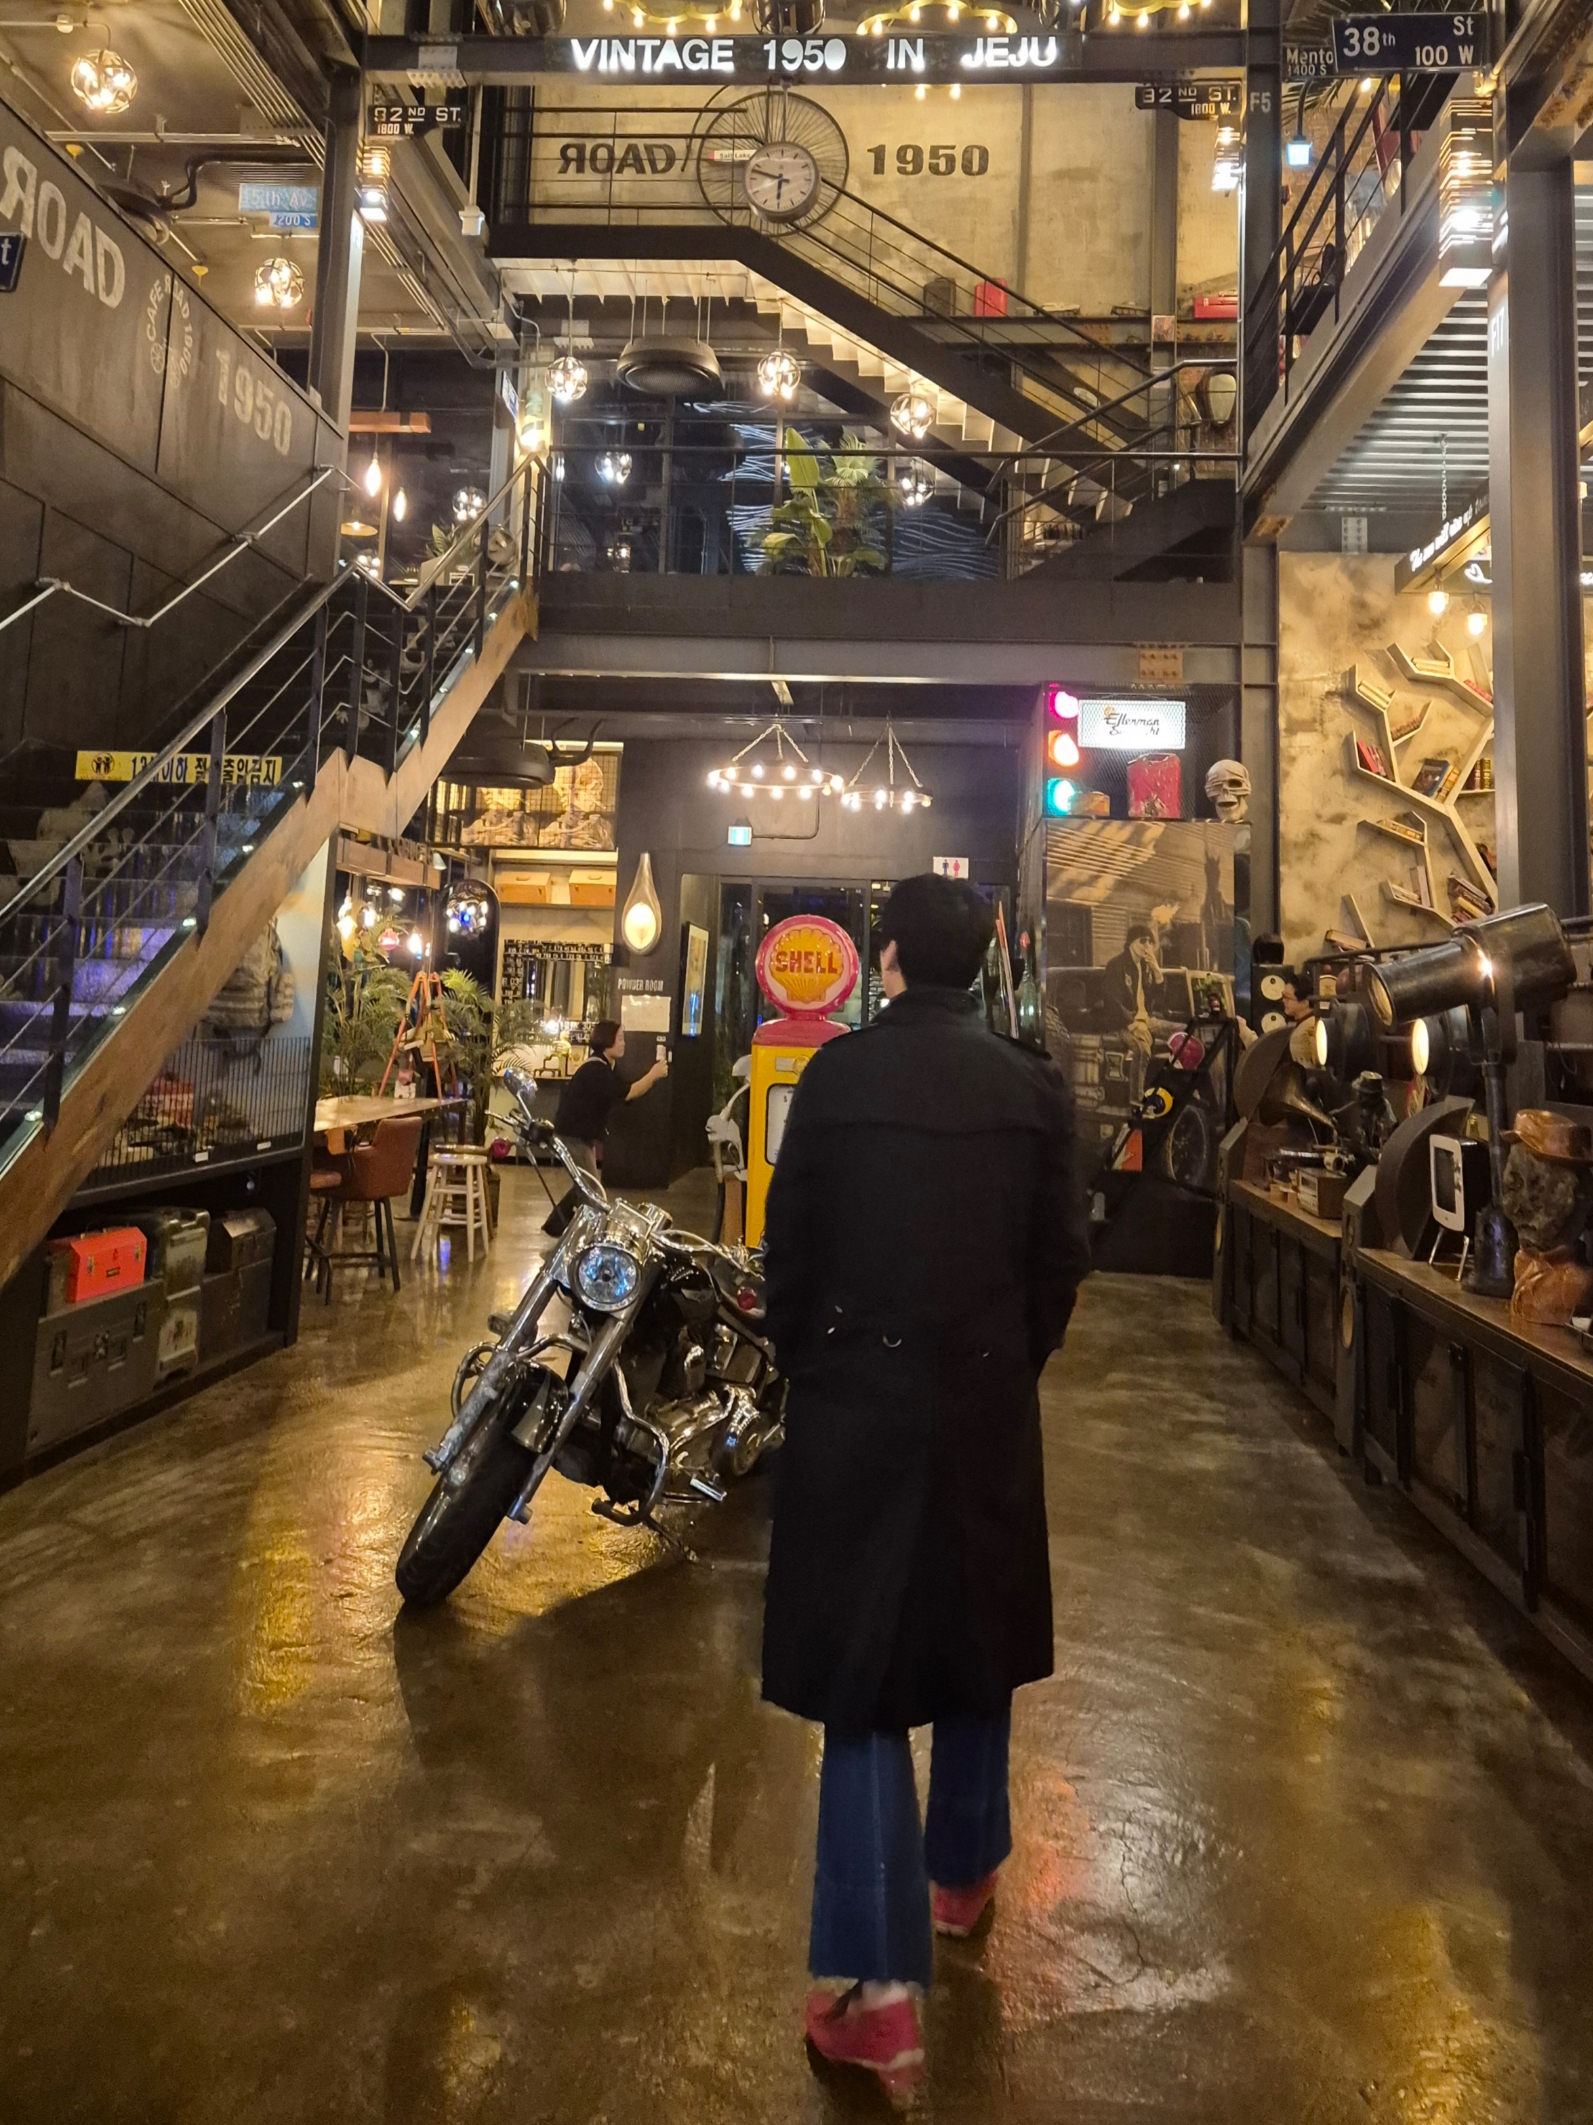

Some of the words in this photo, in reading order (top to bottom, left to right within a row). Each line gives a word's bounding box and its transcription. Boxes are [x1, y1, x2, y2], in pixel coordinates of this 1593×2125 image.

[1343, 26, 1396, 57] 38th
[1453, 16, 1474, 36] St
[571, 39, 735, 71] VINTAGE
[764, 38, 847, 71] 1950
[886, 38, 925, 71] IN
[961, 36, 1057, 68] JEJU
[1415, 45, 1448, 66] 100
[1458, 45, 1474, 64] W
[435, 107, 461, 121] ST.
[1250, 92, 1271, 113] F5
[867, 144, 989, 176] 1950
[147, 280, 164, 342] CAFE
[216, 350, 292, 456] 1950
[775, 950, 838, 974] SHELL
[618, 978, 643, 991] POWDER
[645, 979, 664, 992] ROOM
